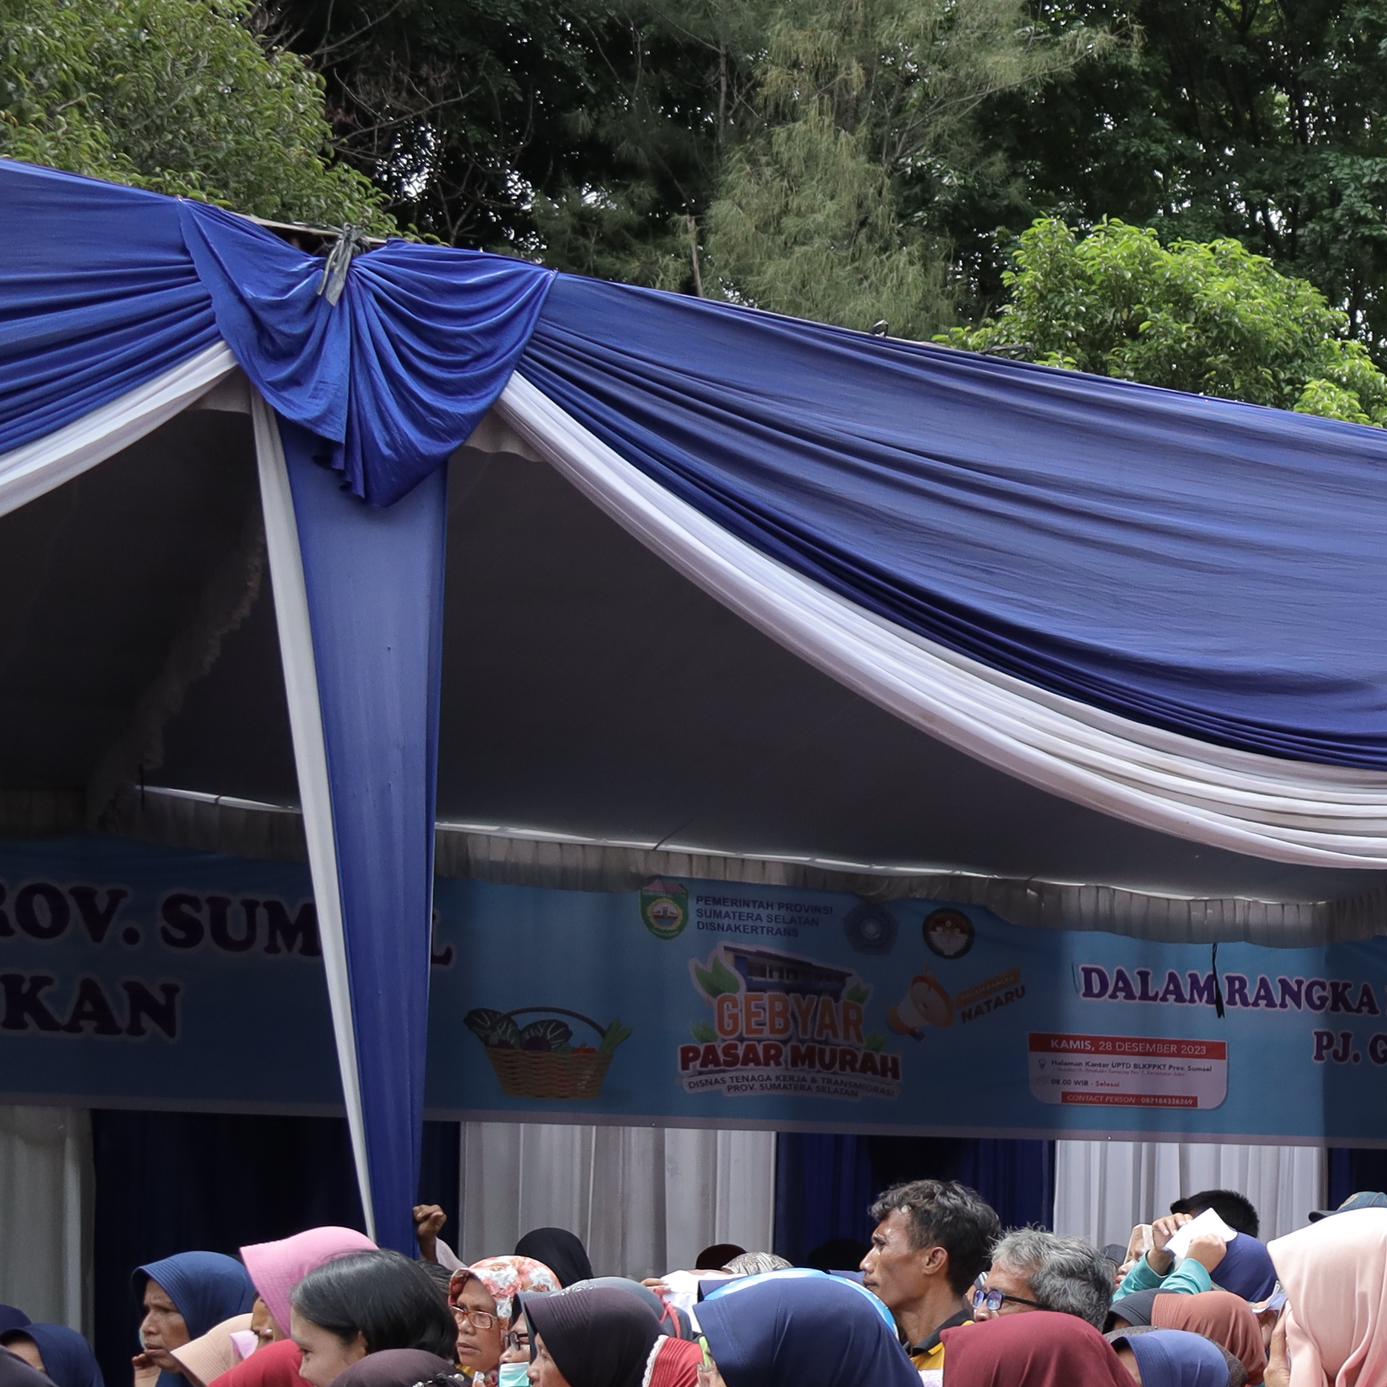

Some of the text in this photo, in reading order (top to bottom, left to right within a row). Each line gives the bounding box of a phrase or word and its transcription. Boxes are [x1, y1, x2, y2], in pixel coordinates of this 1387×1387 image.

[0, 882, 141, 945] OV.
[696, 896, 833, 915] PEMERINTAH PROVINSI
[696, 908, 819, 927] SUMATERA SELATAN
[696, 921, 799, 938] DISNAKERTRANS
[1081, 966, 1215, 1005] DALAM
[1226, 975, 1377, 1014] RANGKA
[715, 993, 866, 1044] GEBYAR
[1050, 1038, 1207, 1056] KAMIS, 28 DESEMBER 2023
[1313, 1030, 1361, 1064] PJ.
[679, 1042, 901, 1081] PASAR MURAH
[730, 1074, 772, 1083] TENAGA
